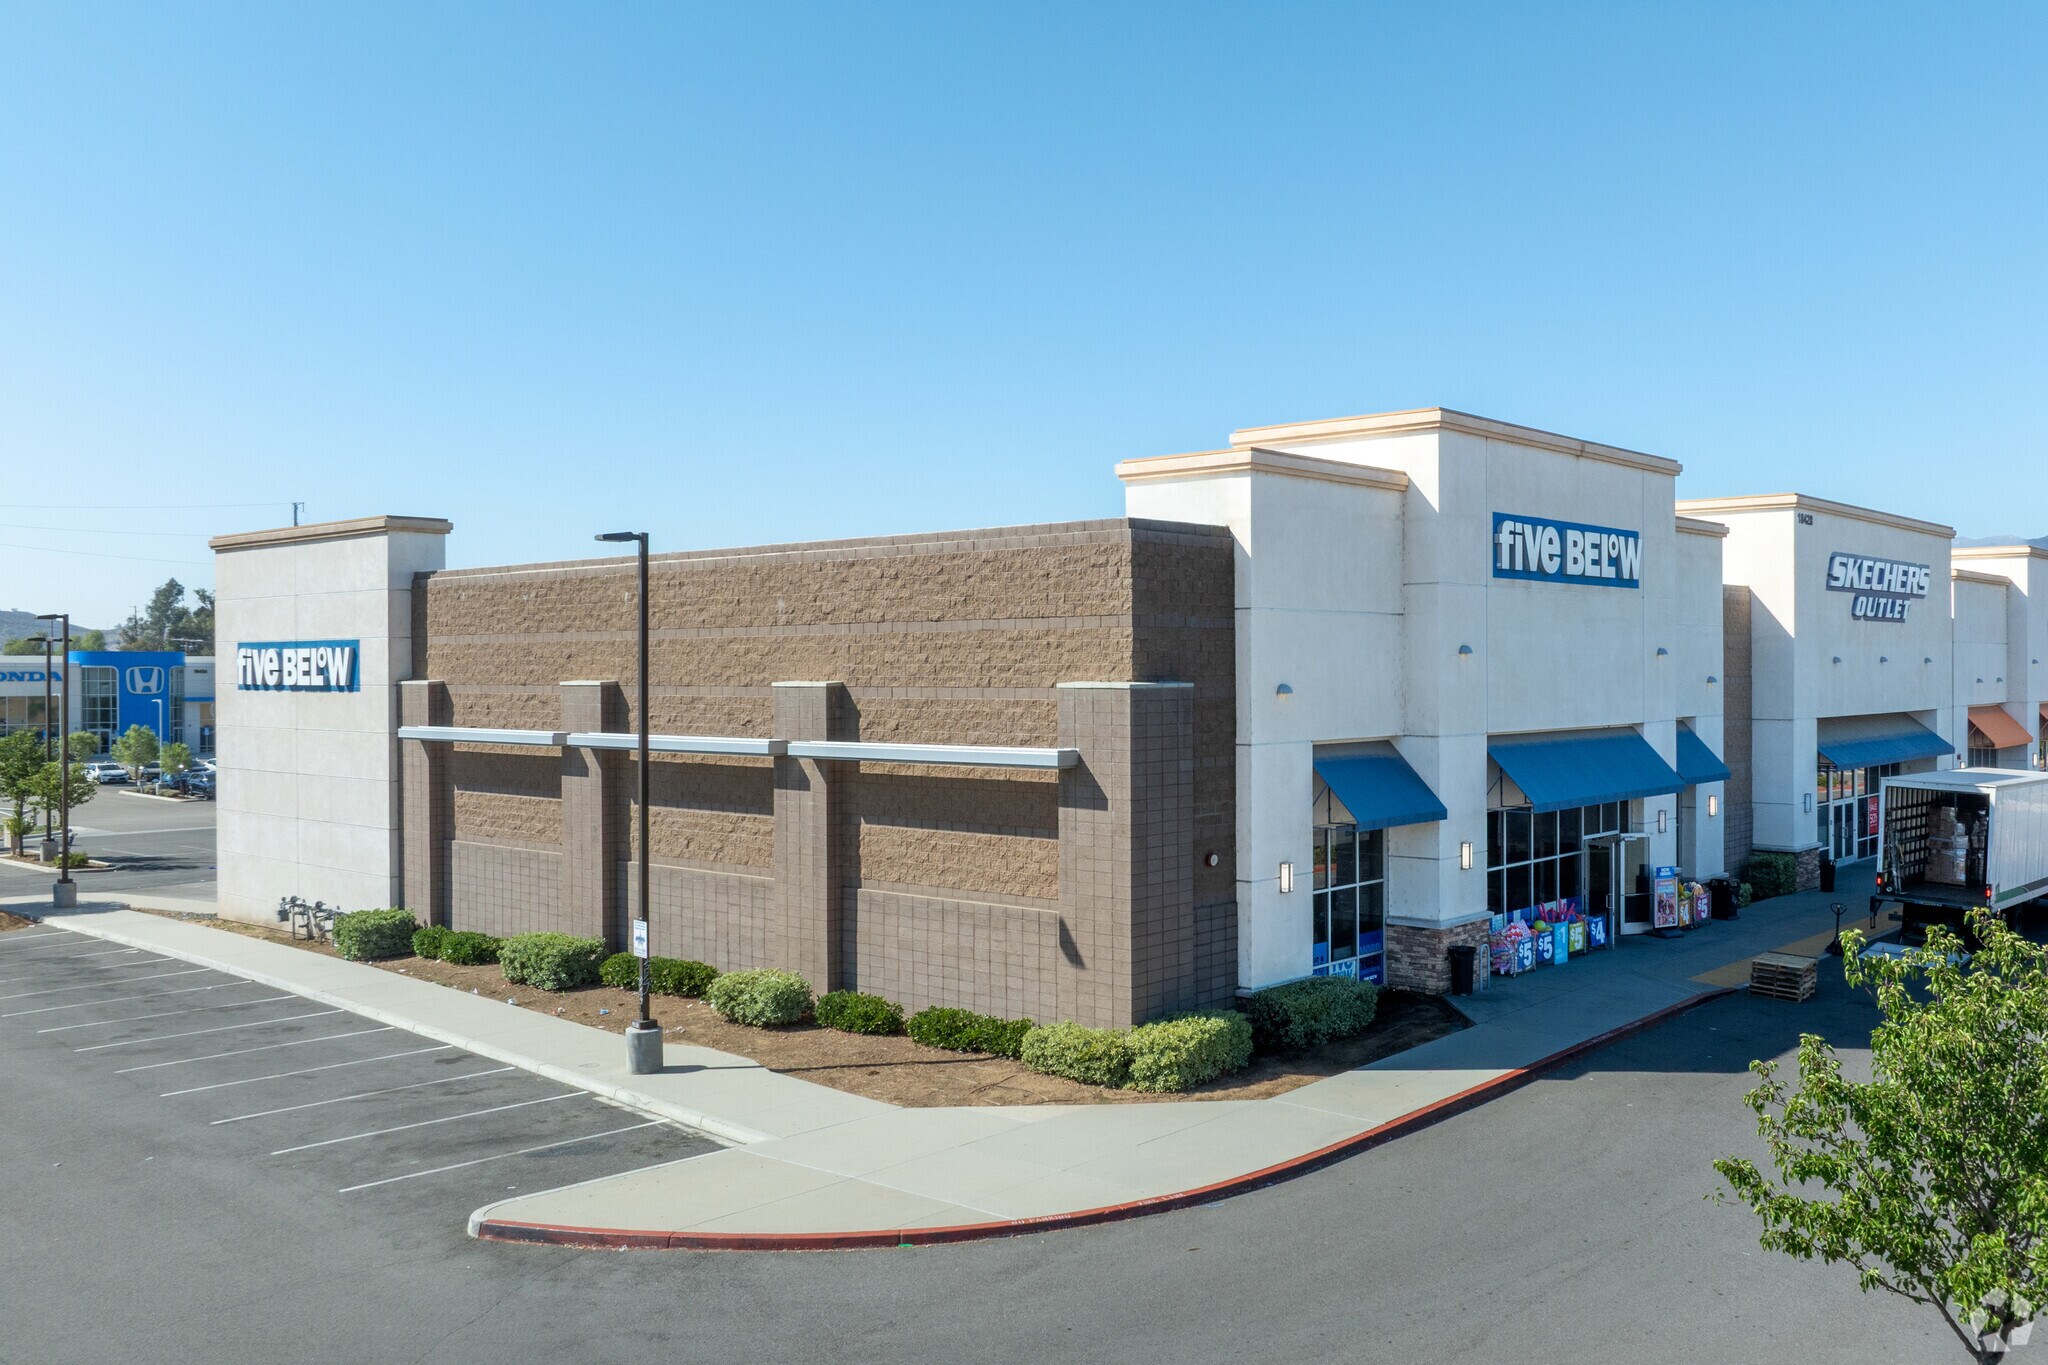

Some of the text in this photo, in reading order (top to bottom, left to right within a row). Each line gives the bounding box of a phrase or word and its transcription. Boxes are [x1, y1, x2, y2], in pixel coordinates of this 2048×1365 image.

[1829, 556, 1931, 595] SKECHERS
[1855, 596, 1911, 619] OUTLET
[1697, 898, 1708, 918] $5
[1556, 926, 1566, 944] $1
[1570, 926, 1583, 950] $5
[1591, 921, 1605, 944] $4
[1519, 942, 1533, 966] $5
[1538, 935, 1553, 959] $5
[1029, 1213, 1071, 1223] PARKING
